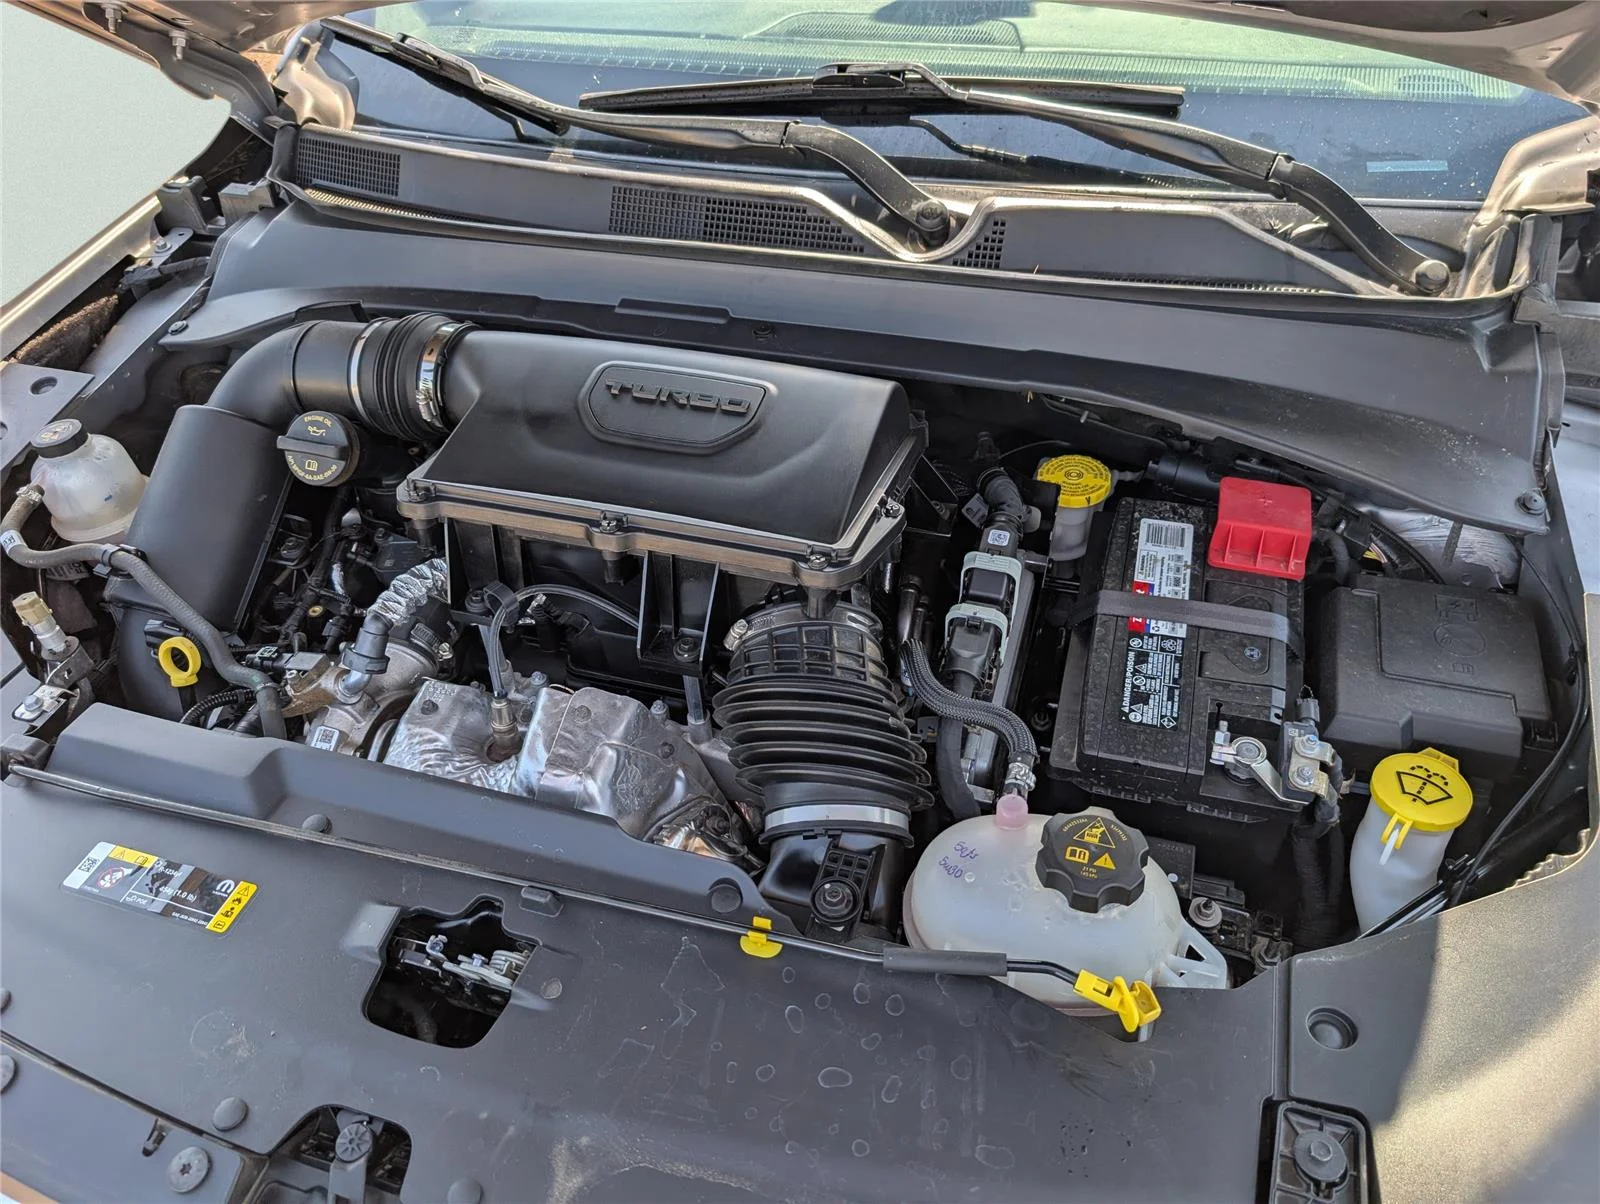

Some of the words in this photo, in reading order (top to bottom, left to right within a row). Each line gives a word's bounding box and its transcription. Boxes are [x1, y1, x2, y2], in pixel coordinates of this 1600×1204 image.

[605, 378, 750, 414] TURBO
[304, 415, 324, 423] ENGINE
[324, 418, 332, 427] OIL
[1122, 651, 1134, 706] DANGER/POISON
